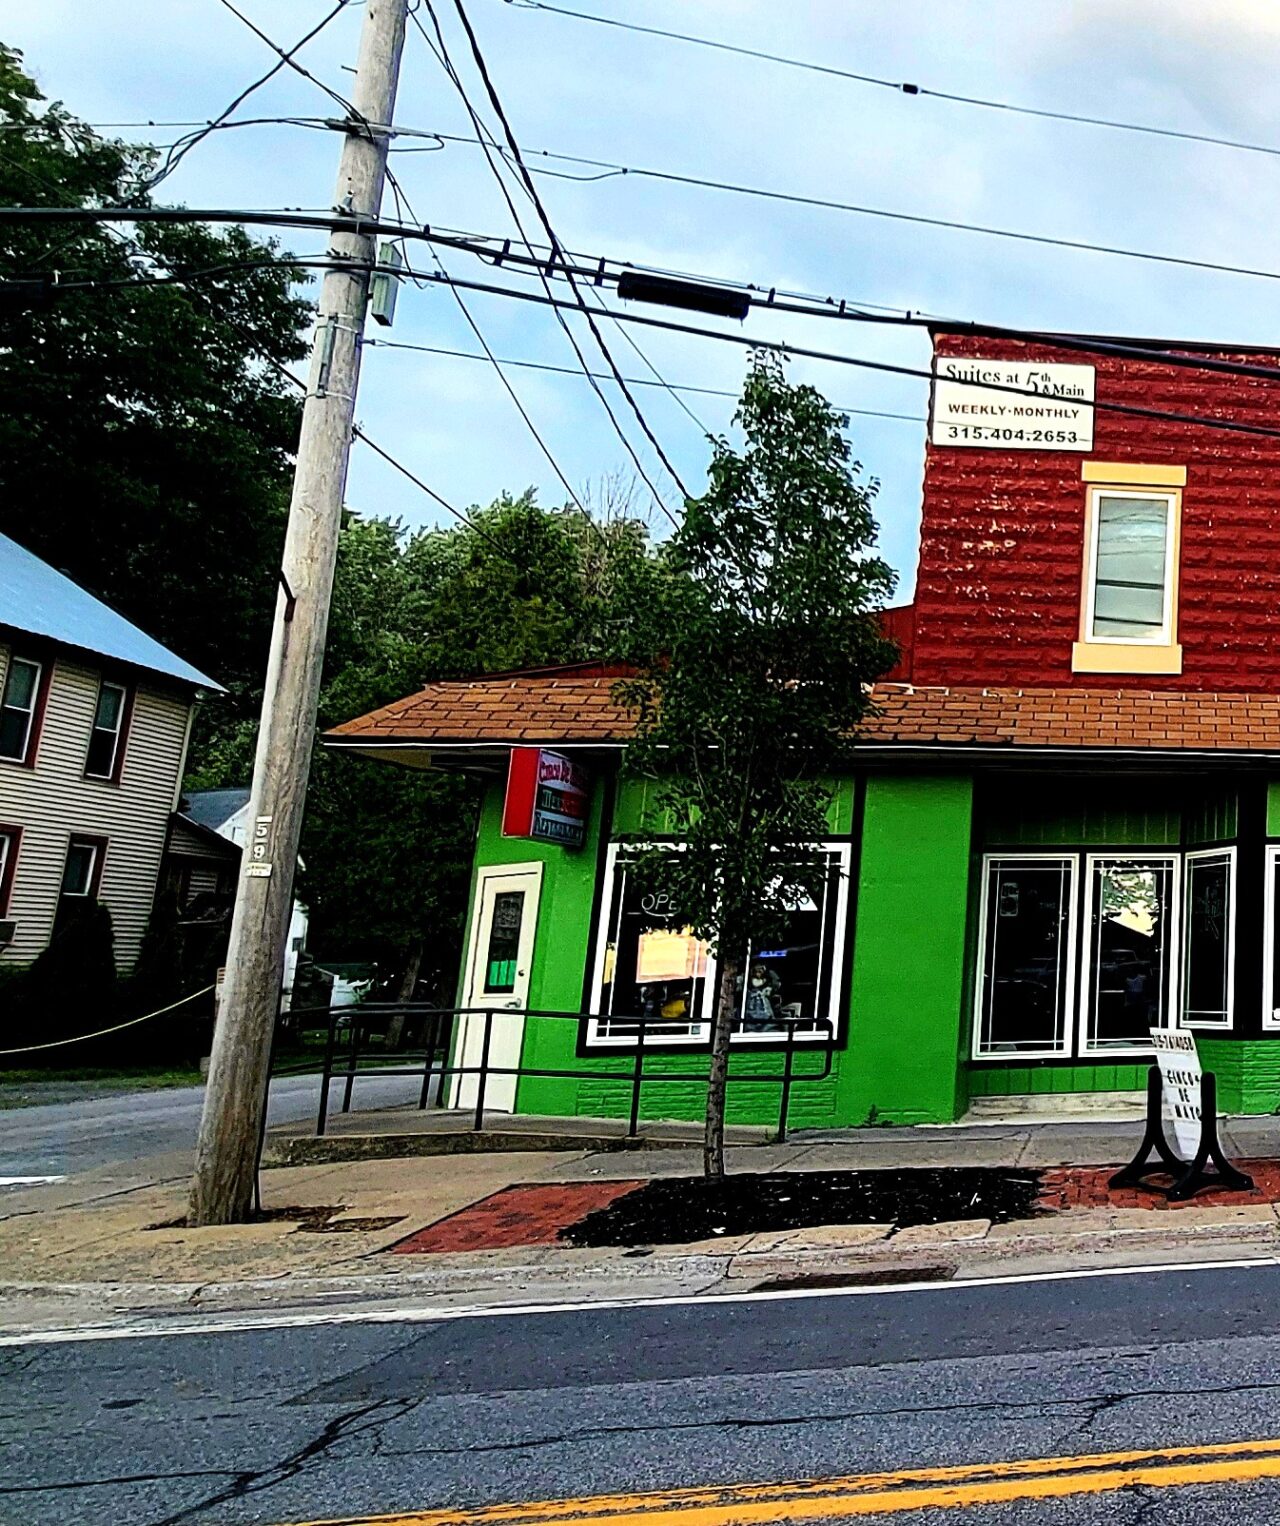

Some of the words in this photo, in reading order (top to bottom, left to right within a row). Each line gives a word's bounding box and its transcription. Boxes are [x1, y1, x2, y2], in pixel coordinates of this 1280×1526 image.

[946, 364, 1000, 383] Suites
[1006, 373, 1019, 384] at
[1026, 371, 1051, 393] 5th
[1052, 383, 1085, 397] Main
[948, 426, 1078, 443] 315.404.2653
